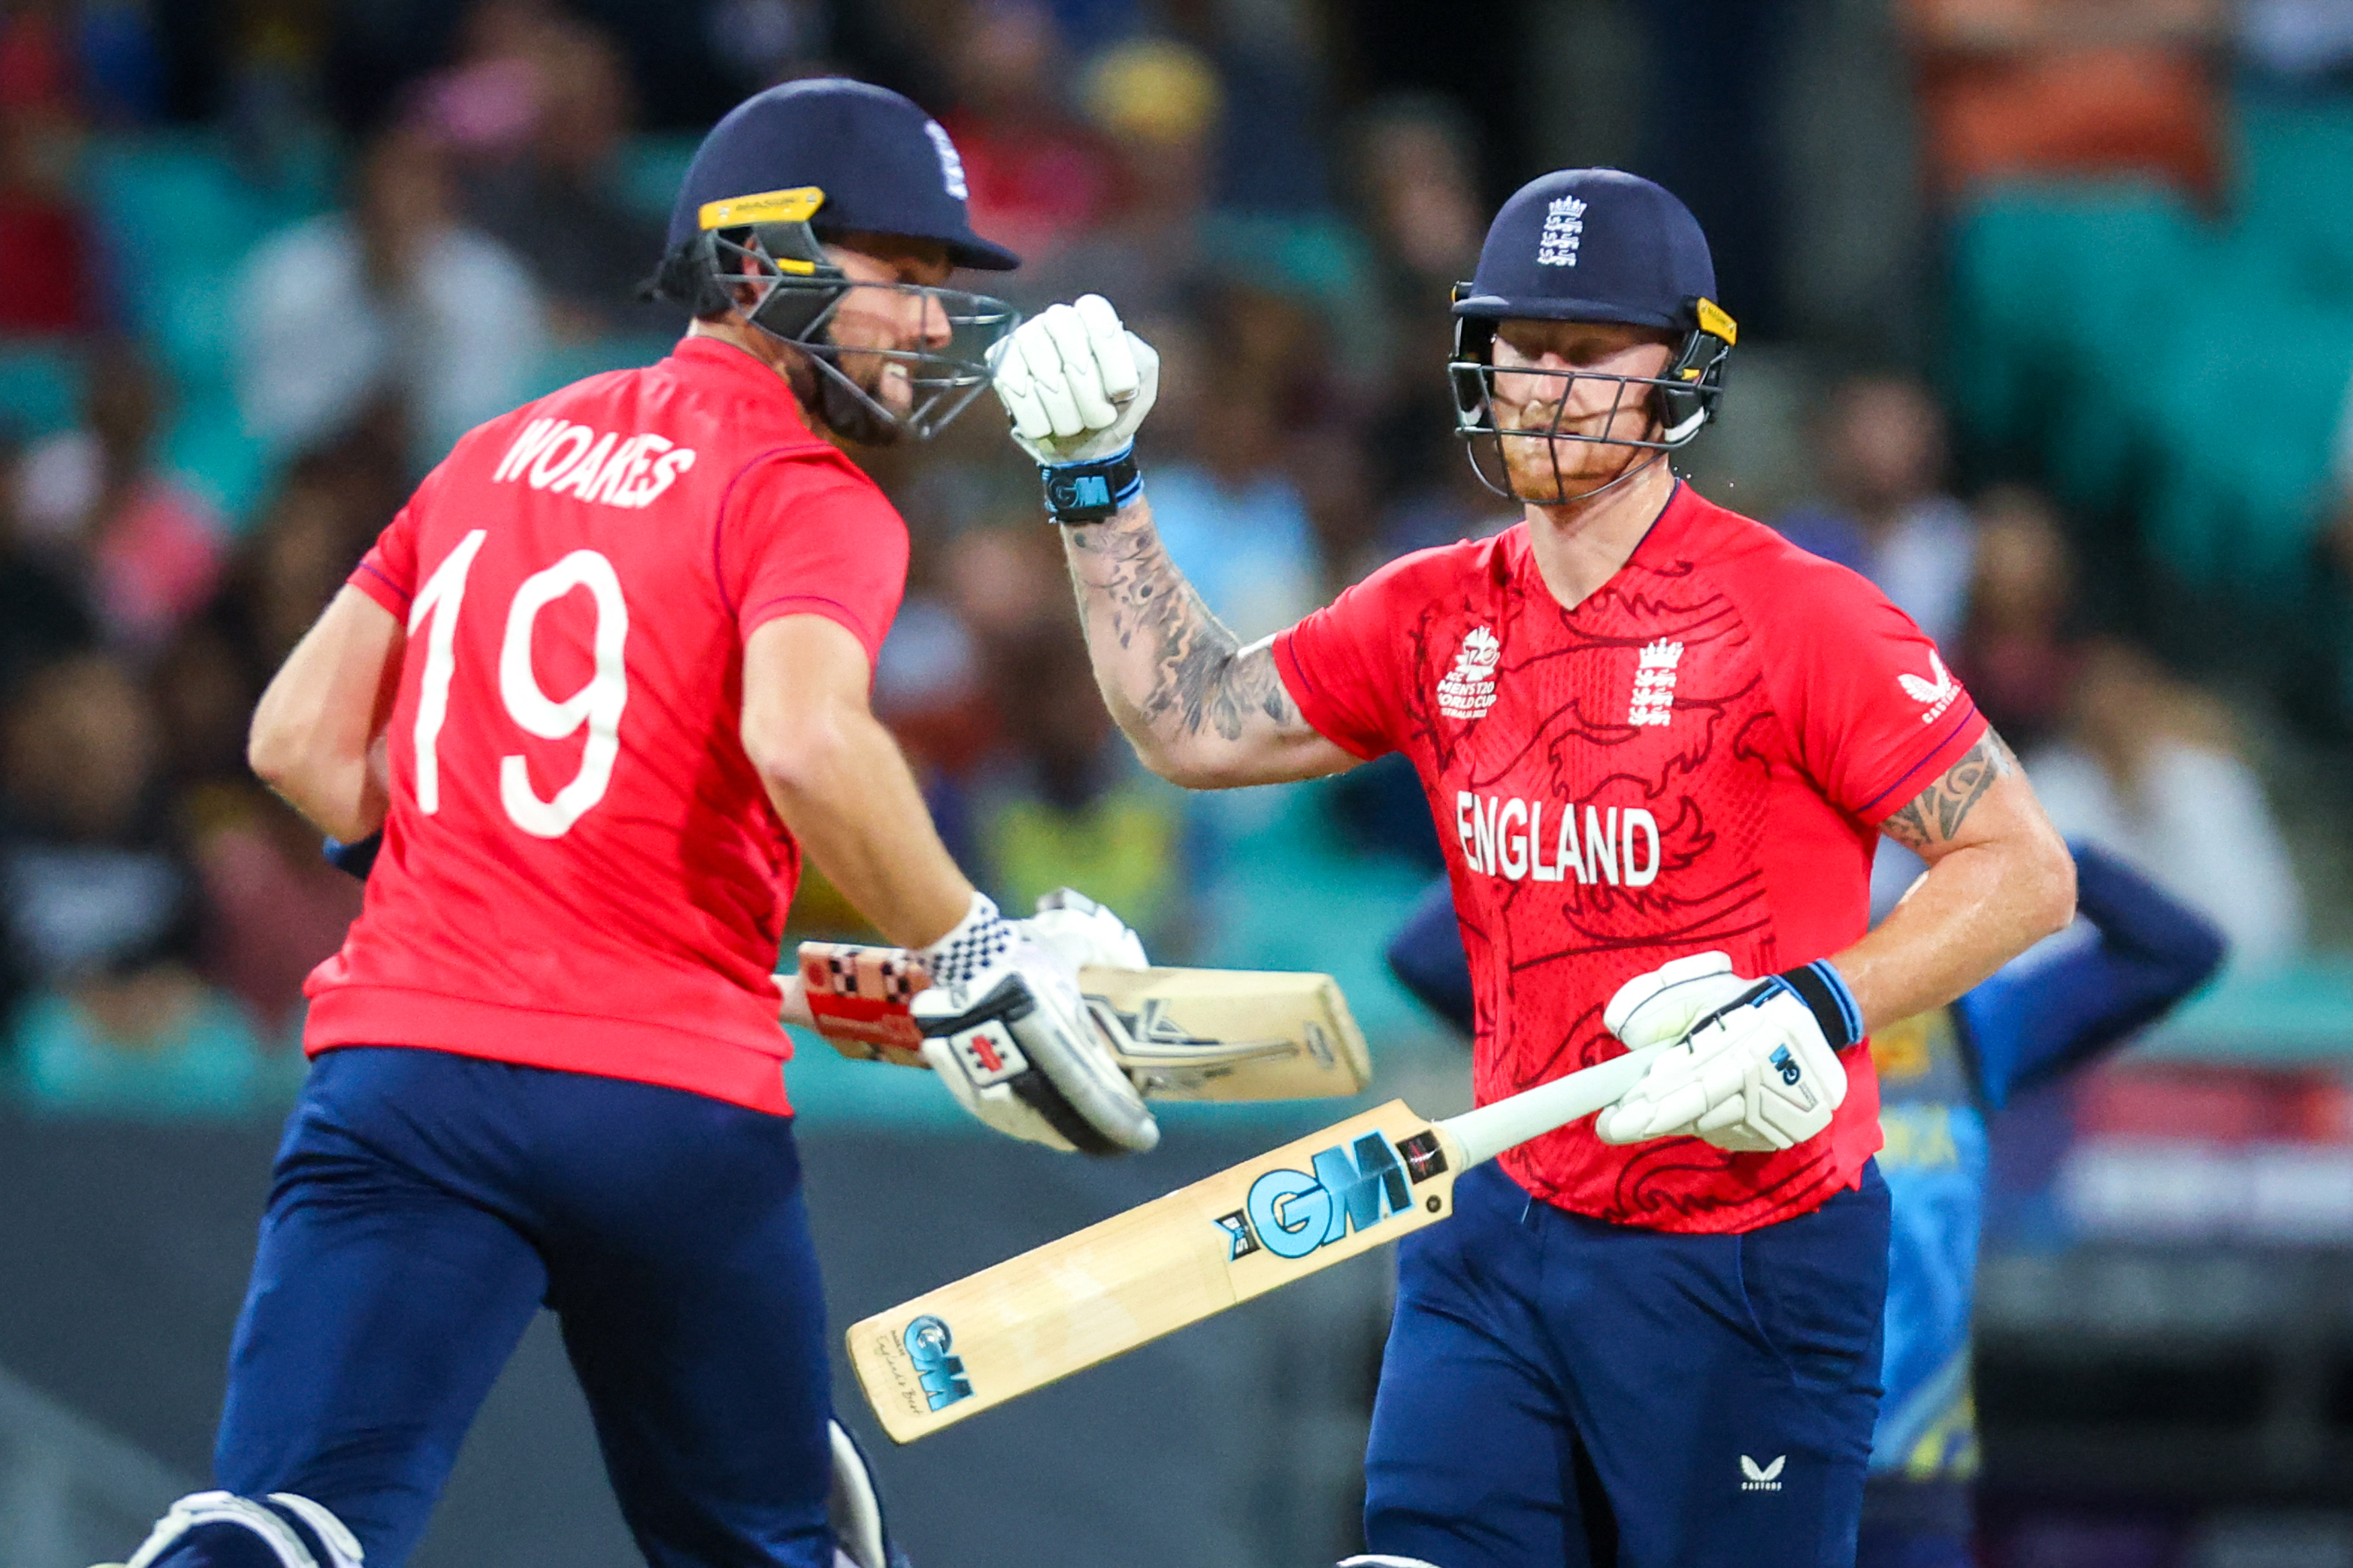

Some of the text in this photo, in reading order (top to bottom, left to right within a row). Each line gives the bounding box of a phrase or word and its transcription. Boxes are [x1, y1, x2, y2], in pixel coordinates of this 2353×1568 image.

[492, 417, 696, 509] WOAKES
[407, 529, 629, 839] 19
[1445, 671, 1465, 682] ICC
[1474, 694, 1498, 708] CUP
[1476, 681, 1496, 695] T20
[1455, 790, 1661, 886] ENGLAND
[1248, 1128, 1413, 1259] GM
[904, 1314, 976, 1412] GM
